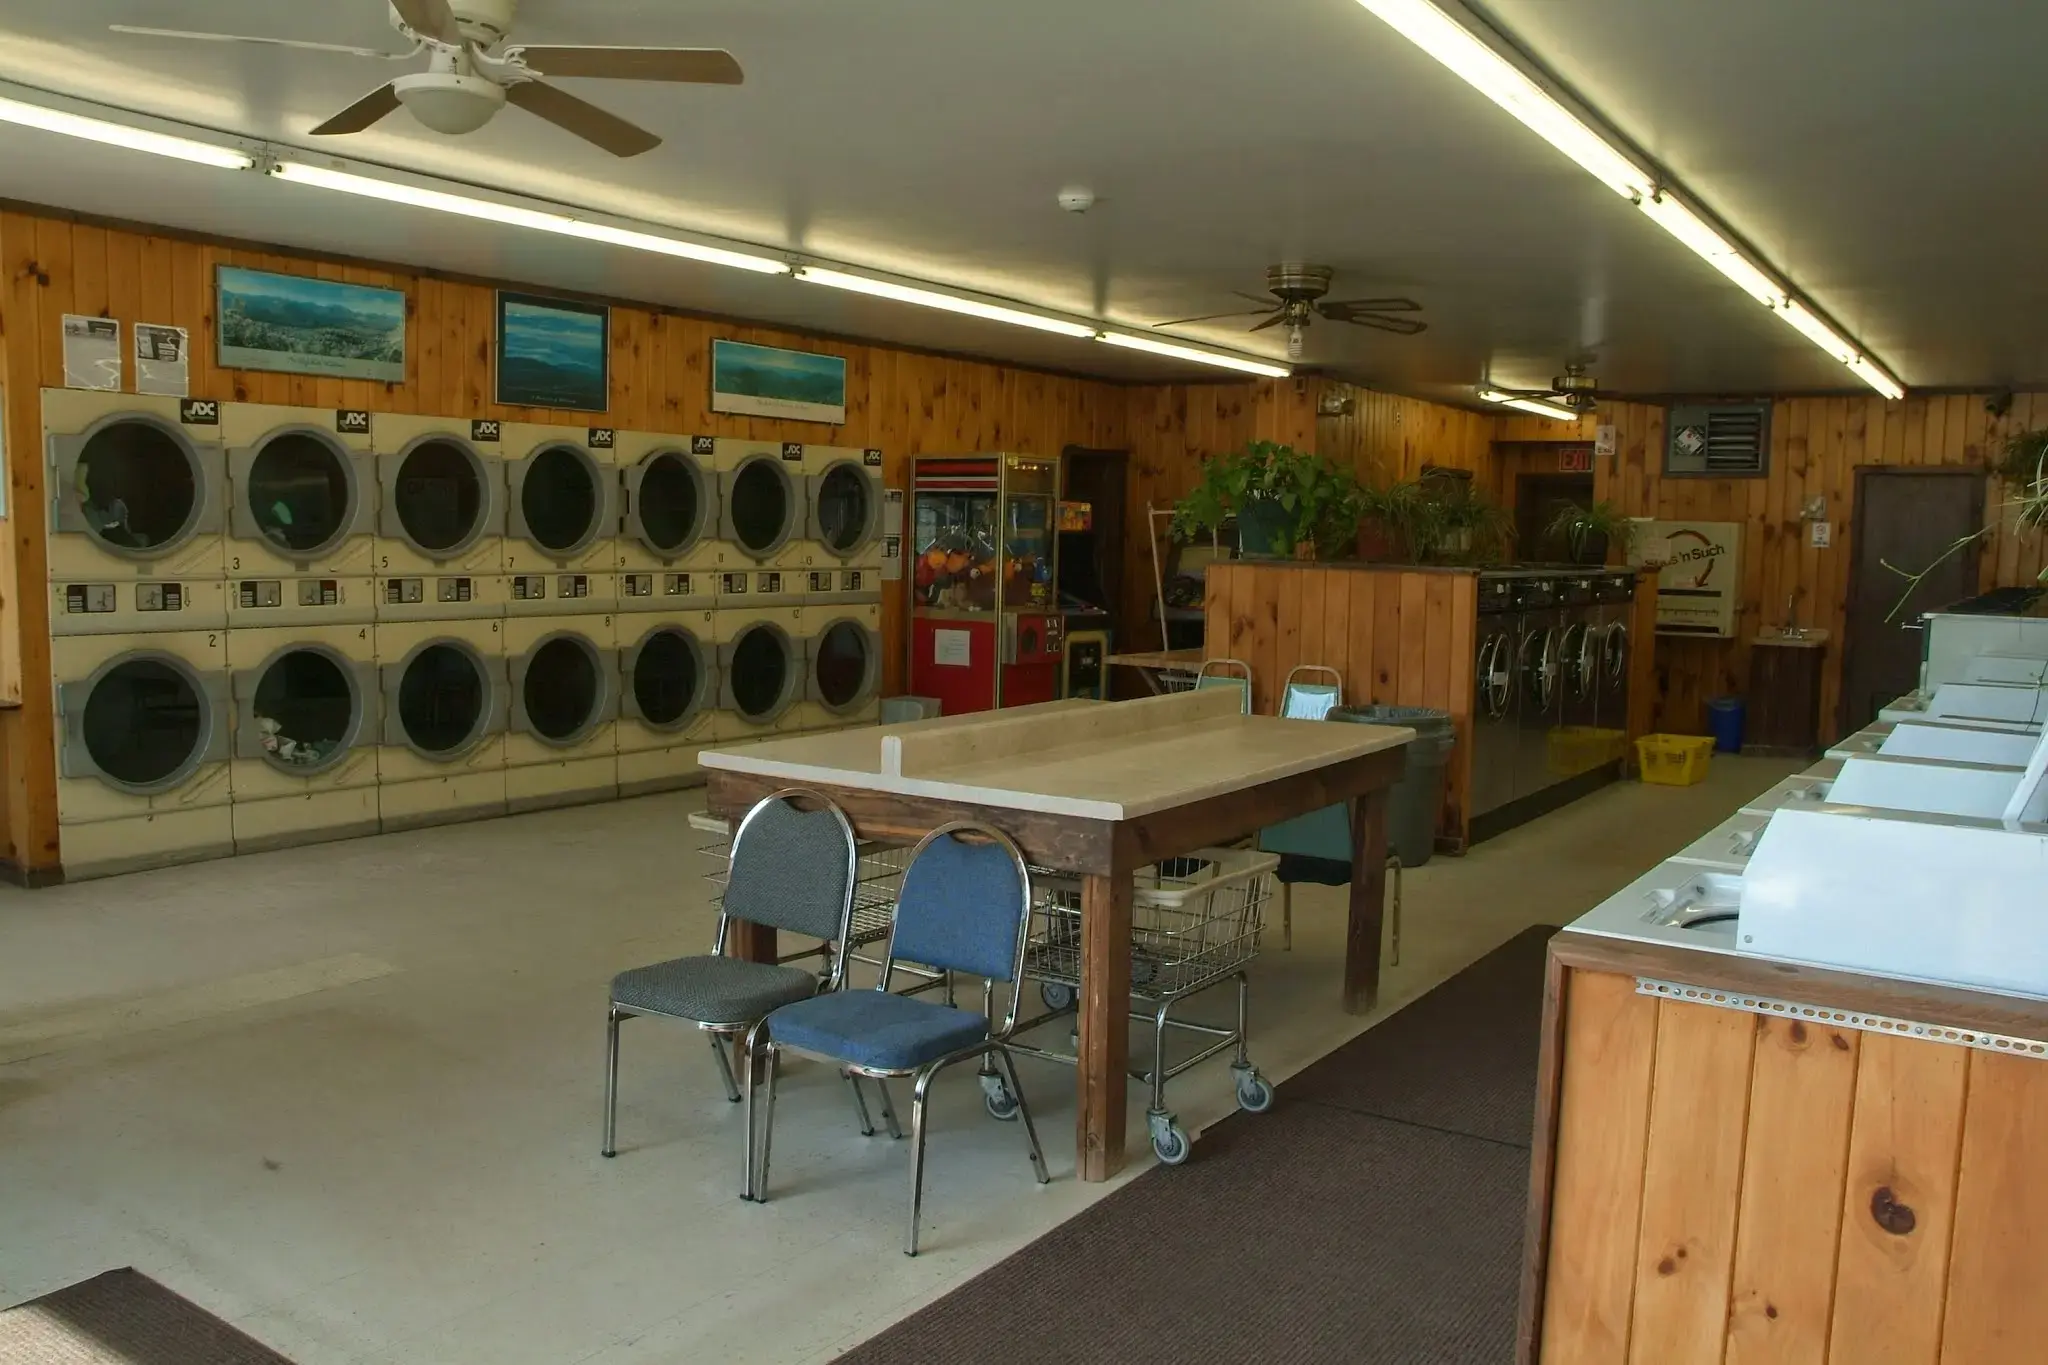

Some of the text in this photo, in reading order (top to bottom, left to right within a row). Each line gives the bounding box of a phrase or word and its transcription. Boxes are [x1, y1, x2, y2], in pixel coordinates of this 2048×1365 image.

[191, 401, 215, 416] ADC
[345, 412, 366, 425] ADC
[1562, 450, 1589, 470] EXIT
[1692, 544, 1725, 560] Such
[232, 557, 240, 570] 3
[382, 556, 389, 568] 5
[508, 556, 514, 568] 7
[620, 556, 625, 567] 9
[605, 615, 610, 627] 8
[704, 611, 711, 622] 10
[492, 621, 498, 632] 6
[359, 628, 365, 640] 4
[208, 634, 216, 648] 2
